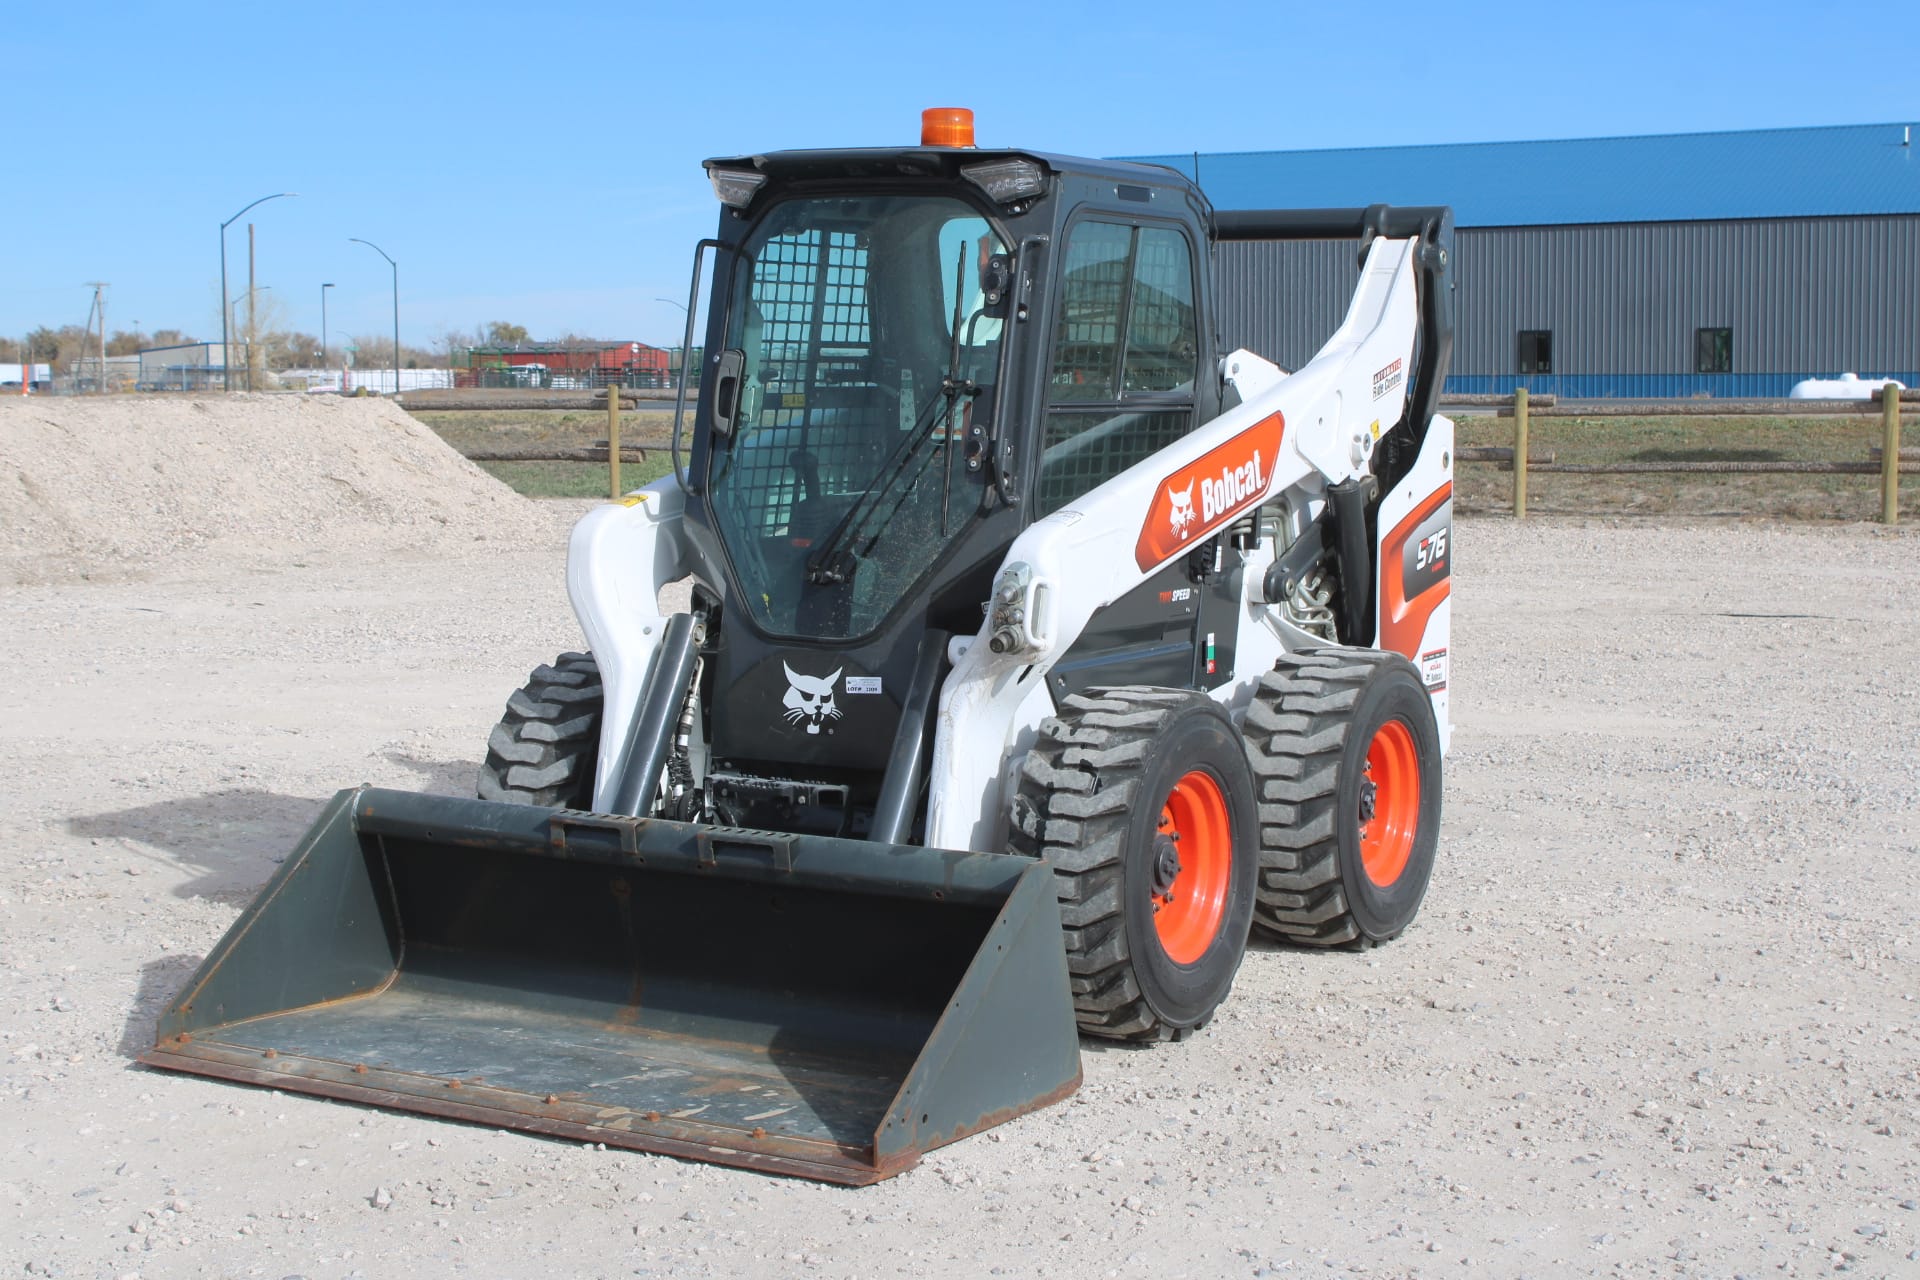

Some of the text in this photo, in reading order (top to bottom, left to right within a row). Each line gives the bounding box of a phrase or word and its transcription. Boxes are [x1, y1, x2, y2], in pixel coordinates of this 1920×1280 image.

[1201, 449, 1263, 523] Bobcat
[1416, 527, 1447, 571] S76
[1172, 588, 1191, 602] SPEED
